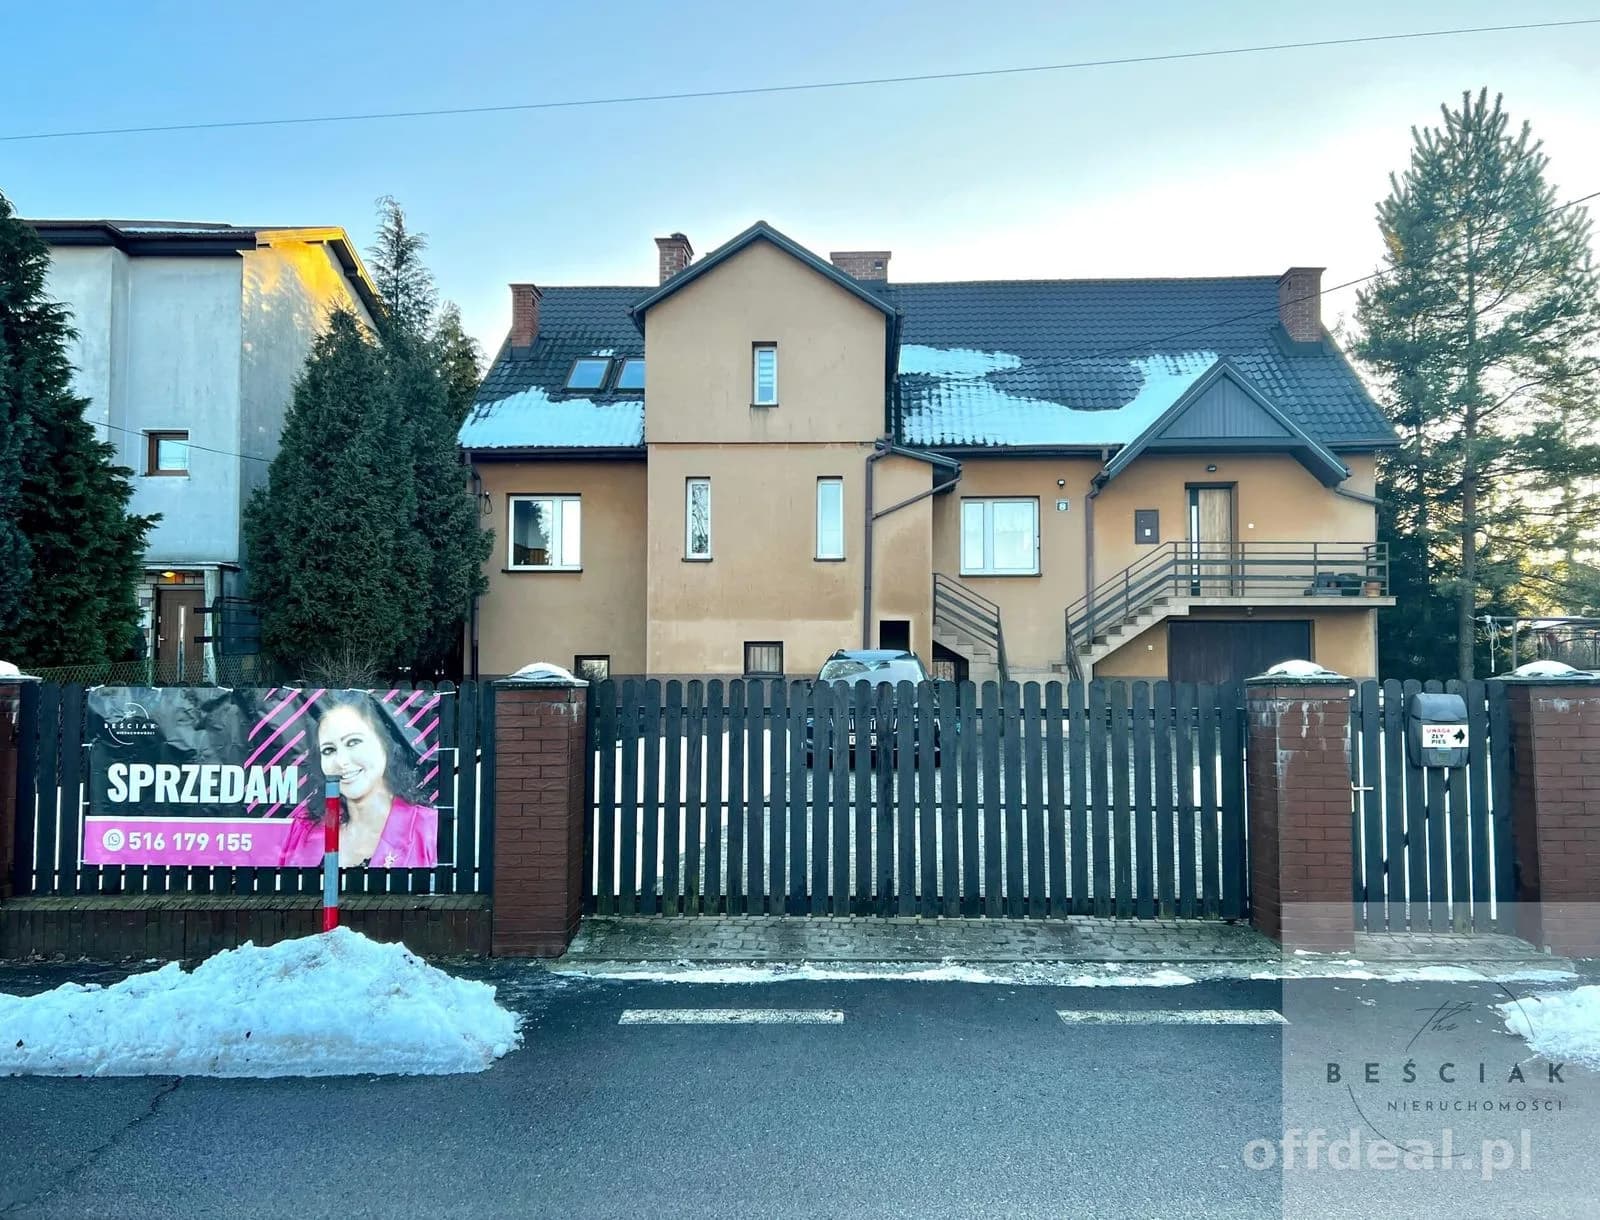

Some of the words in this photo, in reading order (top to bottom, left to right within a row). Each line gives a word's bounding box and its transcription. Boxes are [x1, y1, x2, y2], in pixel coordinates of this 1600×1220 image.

[107, 763, 298, 804] SPRZEDAM
[128, 832, 165, 850] 516
[172, 832, 208, 851] 179
[215, 833, 252, 852] 155
